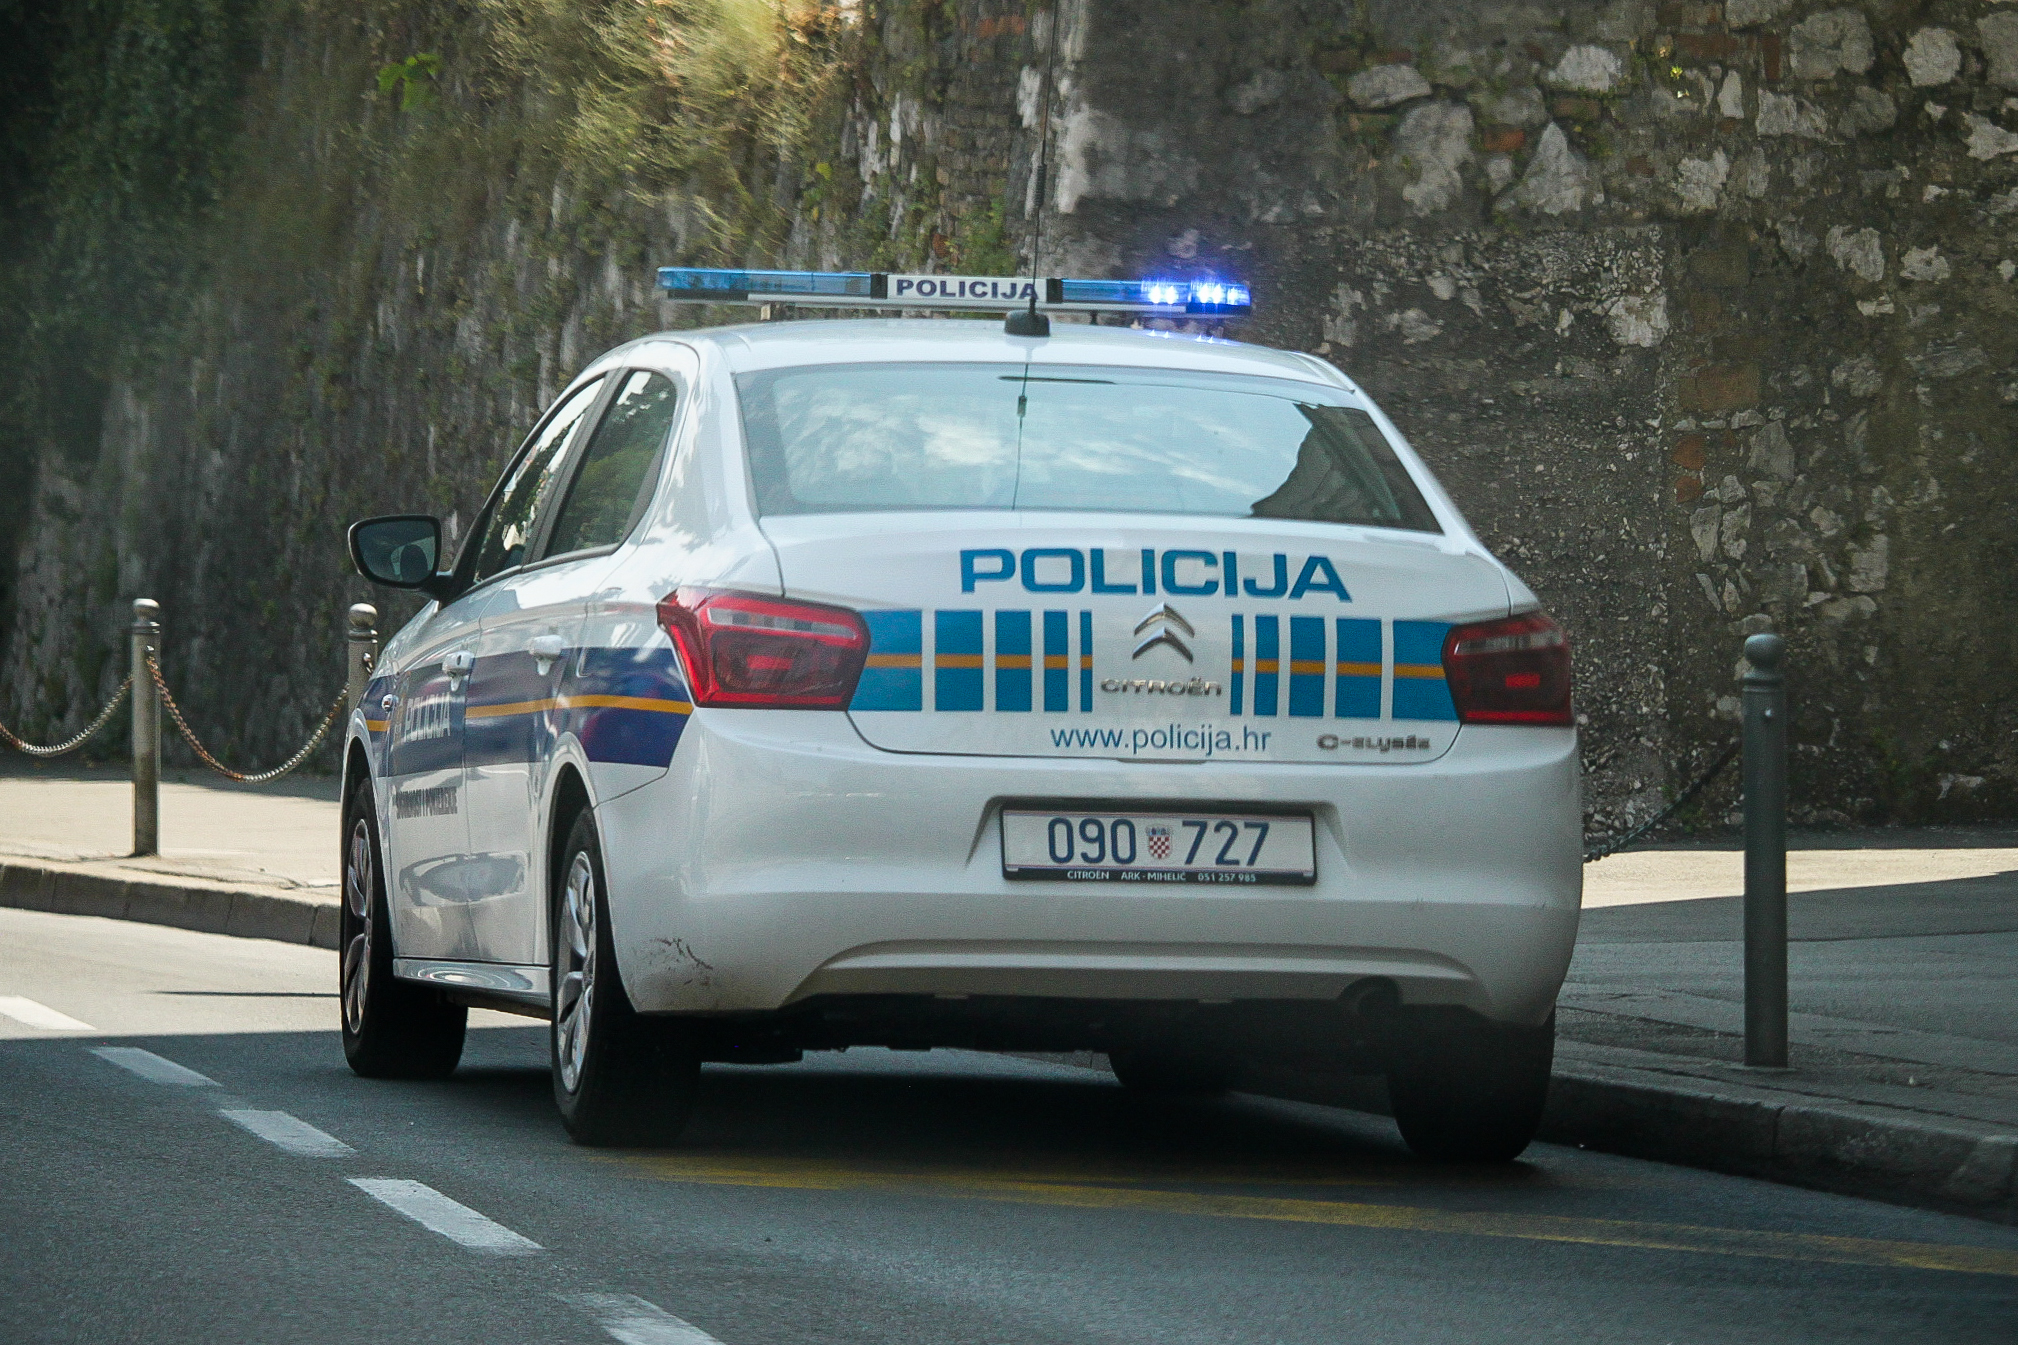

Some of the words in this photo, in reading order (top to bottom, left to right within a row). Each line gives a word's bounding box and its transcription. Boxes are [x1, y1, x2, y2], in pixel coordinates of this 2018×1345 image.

[896, 279, 1038, 300] POLICIJA
[960, 548, 1353, 603] POLICIJA
[1050, 724, 1272, 756] www.policija.hr
[1047, 817, 1137, 864] 090
[1182, 820, 1270, 867] 727
